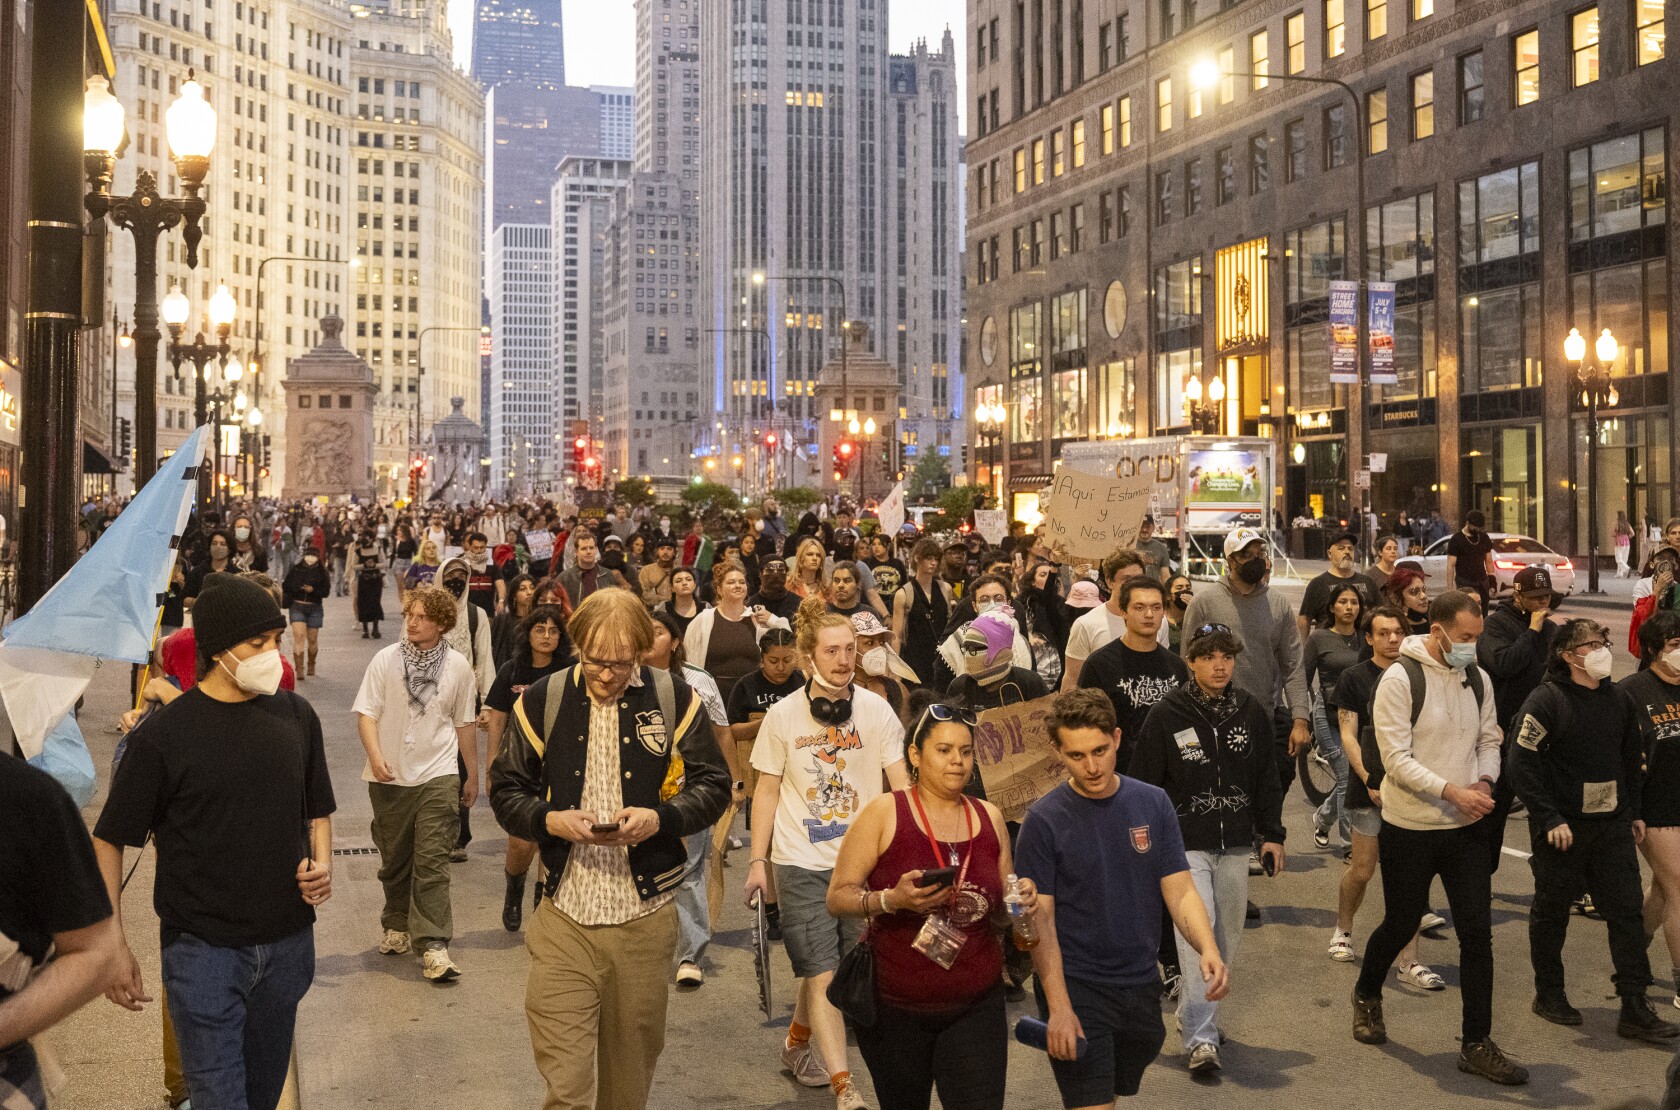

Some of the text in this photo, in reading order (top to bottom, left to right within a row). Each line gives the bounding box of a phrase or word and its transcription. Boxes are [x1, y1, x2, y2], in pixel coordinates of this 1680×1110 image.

[1332, 292, 1356, 300] STREET
[1332, 299, 1355, 308] HOME
[1375, 298, 1391, 307] JULY
[1384, 410, 1418, 421] STARBUCKS
[1107, 486, 1150, 502] Estamos
[1051, 517, 1138, 540] No Nos Vamos
[794, 733, 829, 750] SPACE
